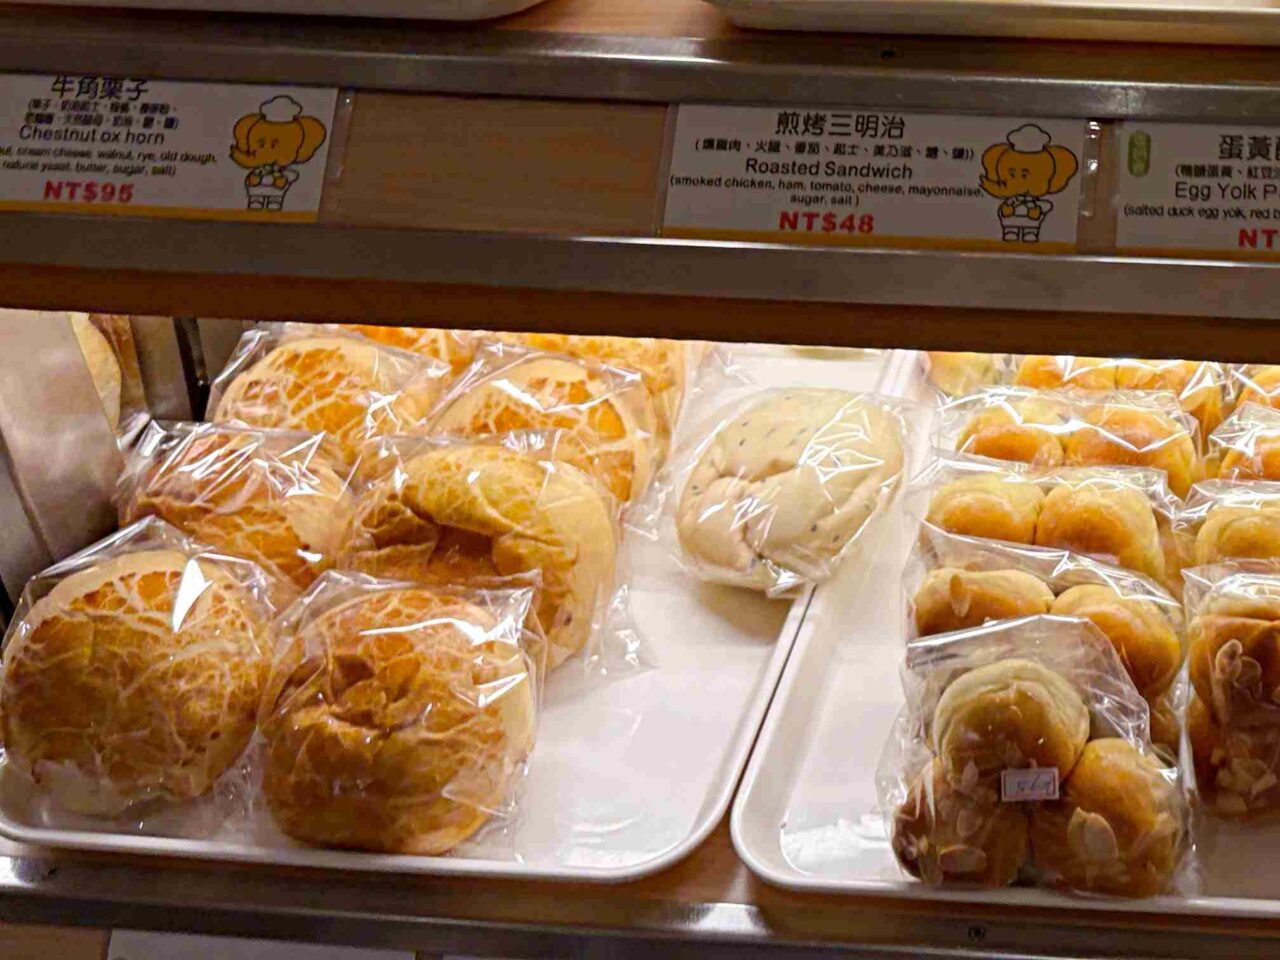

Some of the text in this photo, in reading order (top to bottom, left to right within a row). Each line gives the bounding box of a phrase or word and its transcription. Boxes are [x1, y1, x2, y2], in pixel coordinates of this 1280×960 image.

[19, 124, 165, 145] Chestnut ox horn
[775, 111, 905, 139] 煎烤三明治
[159, 150, 178, 162] old
[179, 151, 217, 167] dough,
[745, 158, 912, 179] Roasted Sandwich
[43, 180, 135, 203] NT$95
[670, 175, 722, 188] (smoked
[724, 176, 775, 189] chicken,
[810, 179, 855, 194] tomato,
[857, 182, 905, 196] cheese,
[908, 185, 984, 198] mayonnaise,
[1175, 180, 1211, 201] Egg
[1217, 182, 1257, 200] Yolk
[1124, 203, 1164, 218] (salted
[1168, 205, 1194, 218] duck
[1198, 207, 1219, 220] egg
[1250, 207, 1270, 220] red
[779, 211, 874, 234] NT$48
